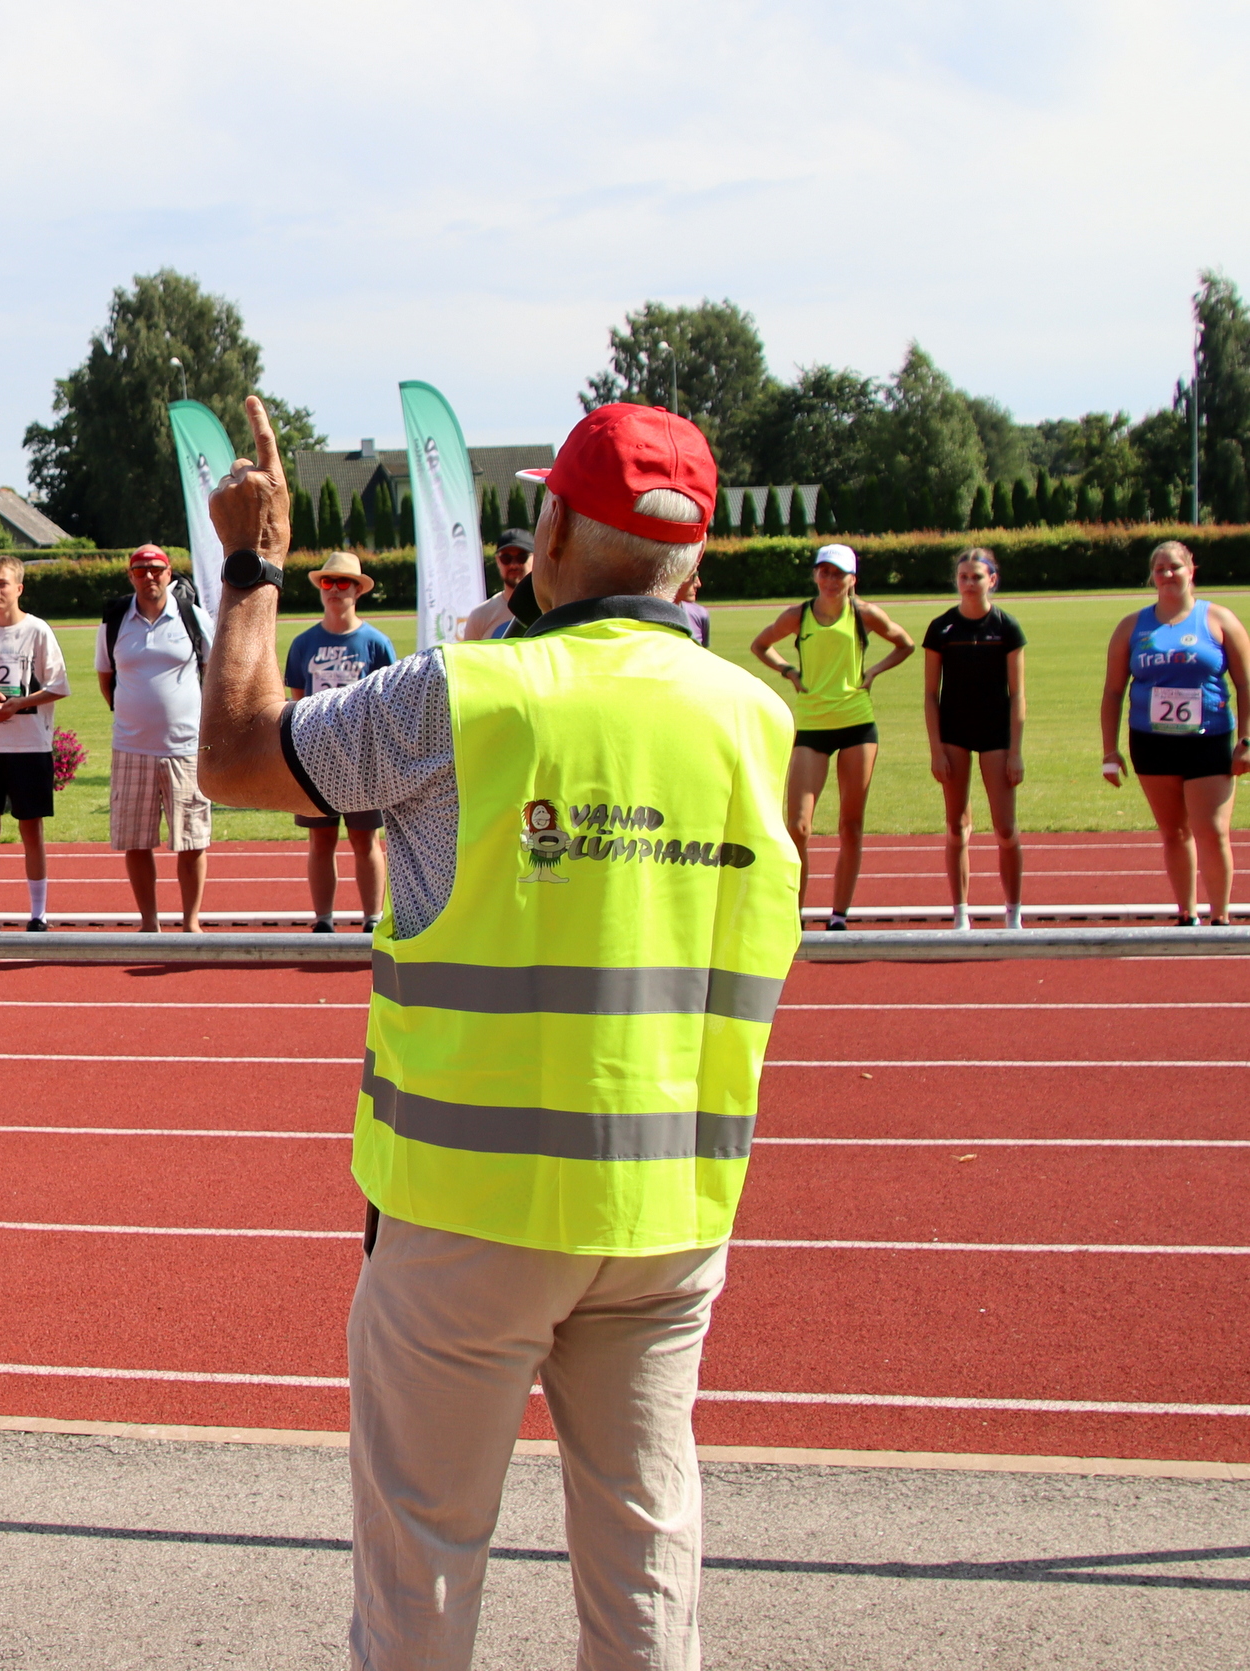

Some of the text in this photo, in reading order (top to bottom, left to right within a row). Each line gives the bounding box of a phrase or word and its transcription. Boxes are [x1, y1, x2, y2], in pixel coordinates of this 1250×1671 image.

[314, 646, 347, 662] JUST
[1159, 701, 1192, 722] 26
[569, 803, 665, 832] VANAD
[567, 828, 756, 869] LÜMPIAALAD
